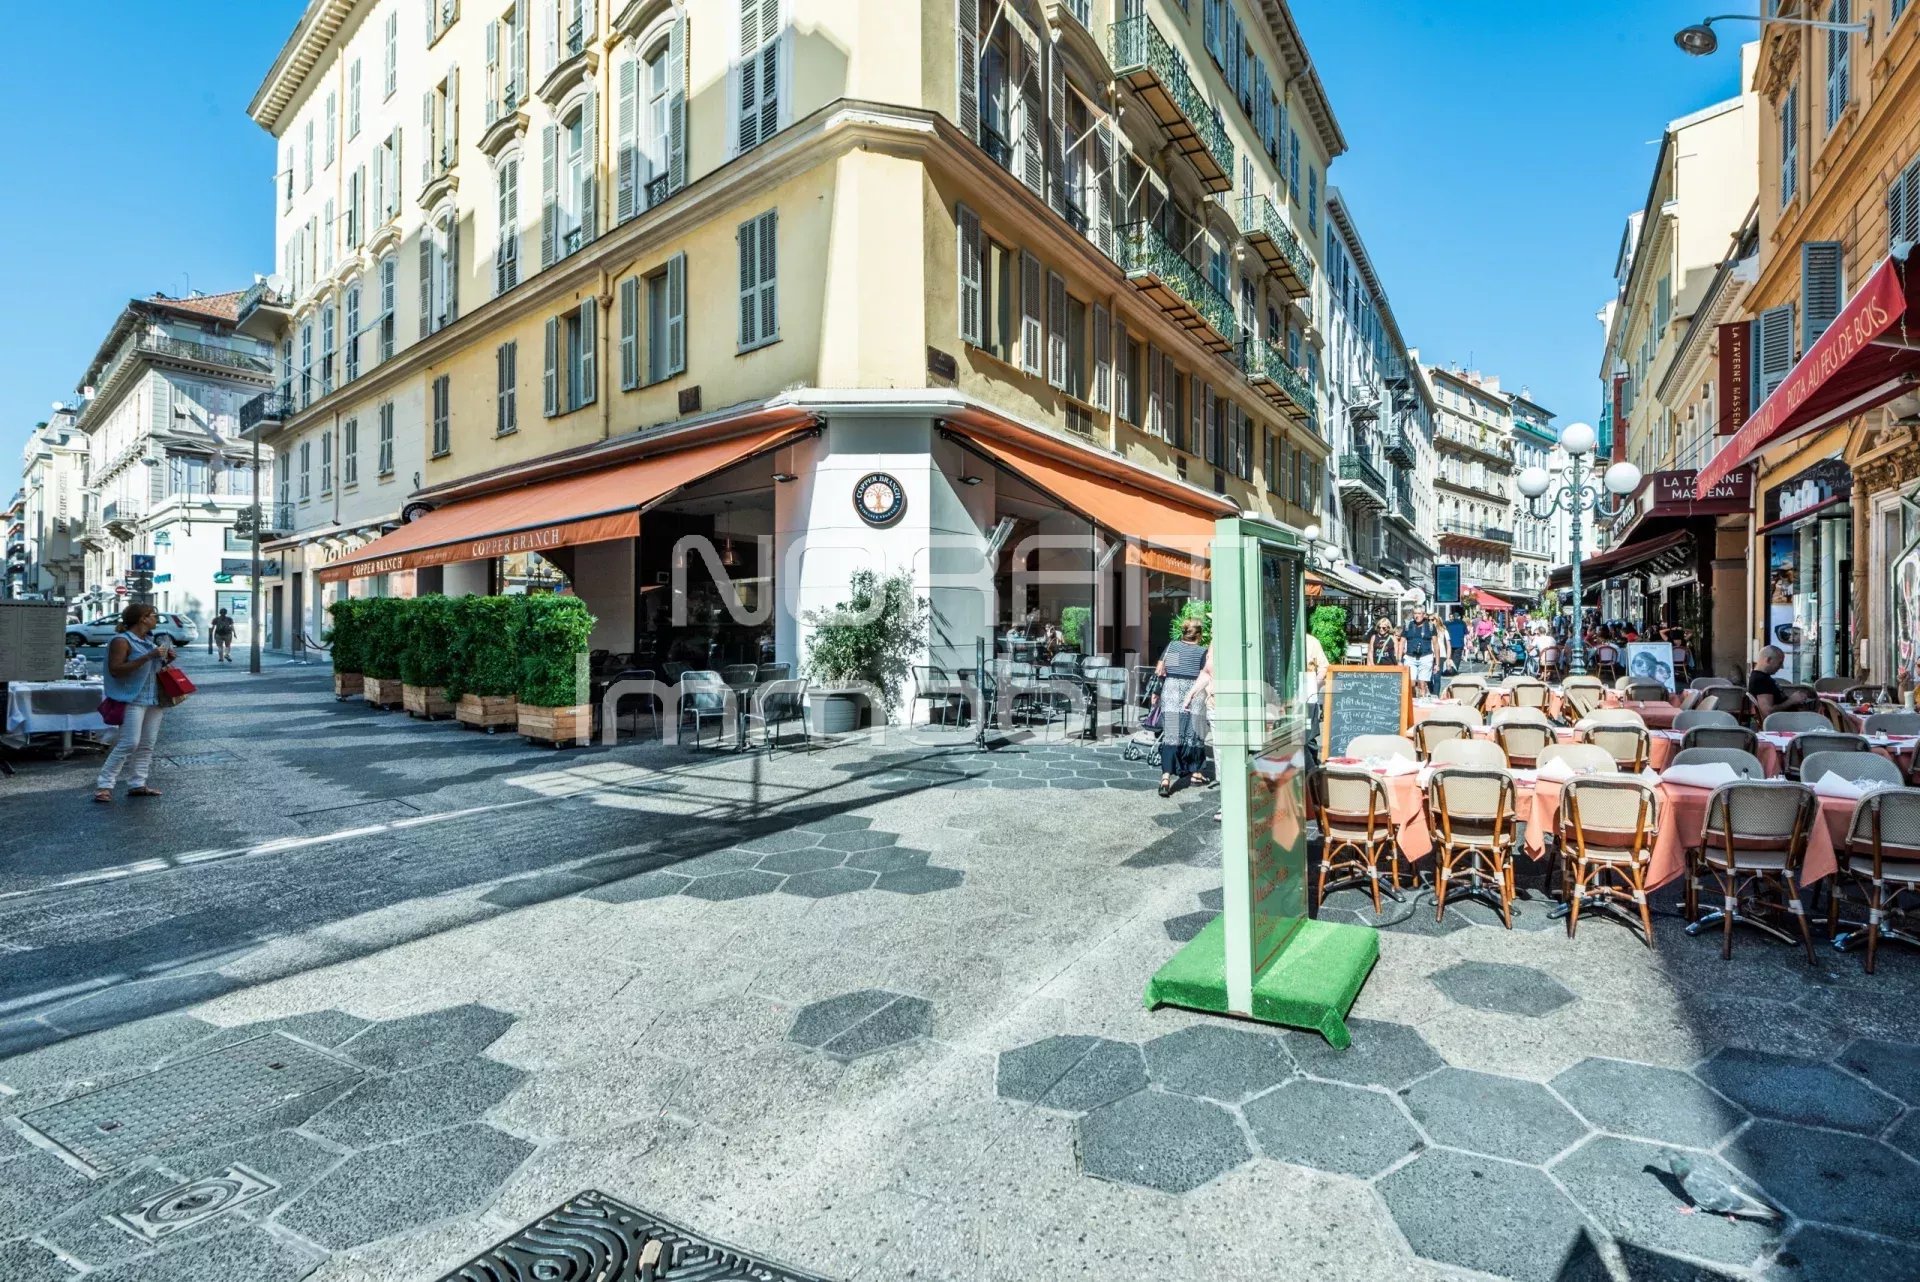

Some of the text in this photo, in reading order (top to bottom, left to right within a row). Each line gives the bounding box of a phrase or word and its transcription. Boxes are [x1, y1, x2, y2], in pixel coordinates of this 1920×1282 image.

[1807, 361, 1820, 393] AU
[1821, 342, 1838, 379] FEU
[1839, 325, 1854, 361] DE
[1854, 296, 1888, 345] BOIS
[1732, 327, 1741, 431] LA TAVERNE MASSENA
[1663, 473, 1744, 487] LA TANE
[1672, 486, 1735, 499] MASENA
[472, 529, 559, 557] COPPER BRANCH
[352, 562, 375, 576] COPPER
[376, 557, 403, 572] BRANCH
